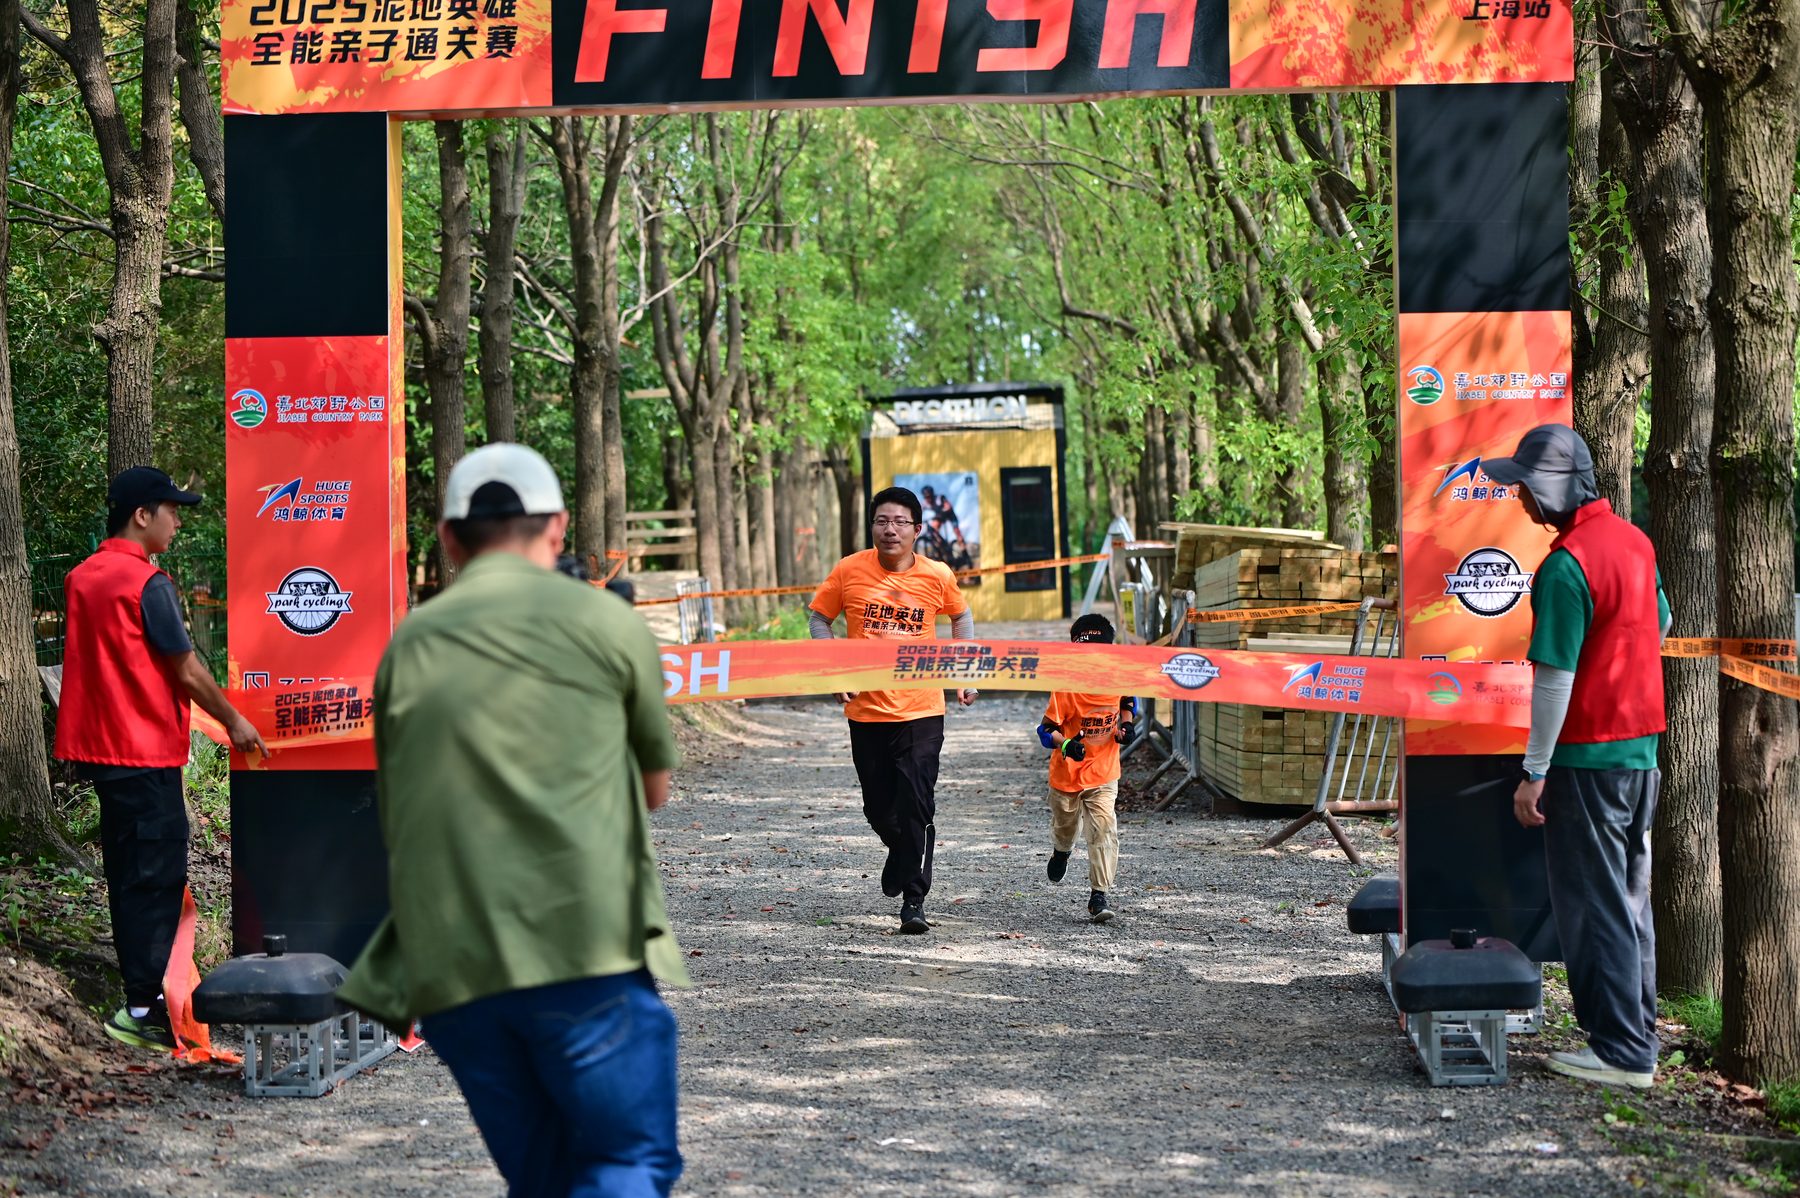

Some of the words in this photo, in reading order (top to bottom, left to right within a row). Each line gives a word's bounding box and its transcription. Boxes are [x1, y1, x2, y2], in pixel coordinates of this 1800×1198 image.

[1463, 0, 1552, 20] 上海站
[250, 25, 518, 65] 全能亲子通关赛
[1454, 373, 1566, 388] 嘉北郊野公园
[1491, 390, 1535, 399] COUNTRY
[1540, 389, 1565, 398] PARK
[276, 396, 384, 412] 嘉北郊野公园
[277, 413, 307, 423] JIABEI
[312, 412, 353, 422] COUNTRY
[359, 412, 382, 421] PARK
[315, 481, 351, 491] HUGE
[300, 494, 348, 504] SPORTS
[1453, 486, 1520, 500] 鸿鲸体
[274, 507, 346, 521] 鸿鲸体育
[1453, 577, 1479, 590] park
[1483, 577, 1525, 589] cycling
[275, 596, 300, 608] park
[303, 596, 344, 608] cycling
[864, 603, 924, 622] 泥地英雄
[894, 656, 1040, 672] 全能亲子通关赛
[1186, 667, 1216, 676] cycling
[1335, 666, 1366, 676] HUGE
[1321, 676, 1363, 688] SPORTS
[1297, 686, 1361, 702] 鸿鲸体育
